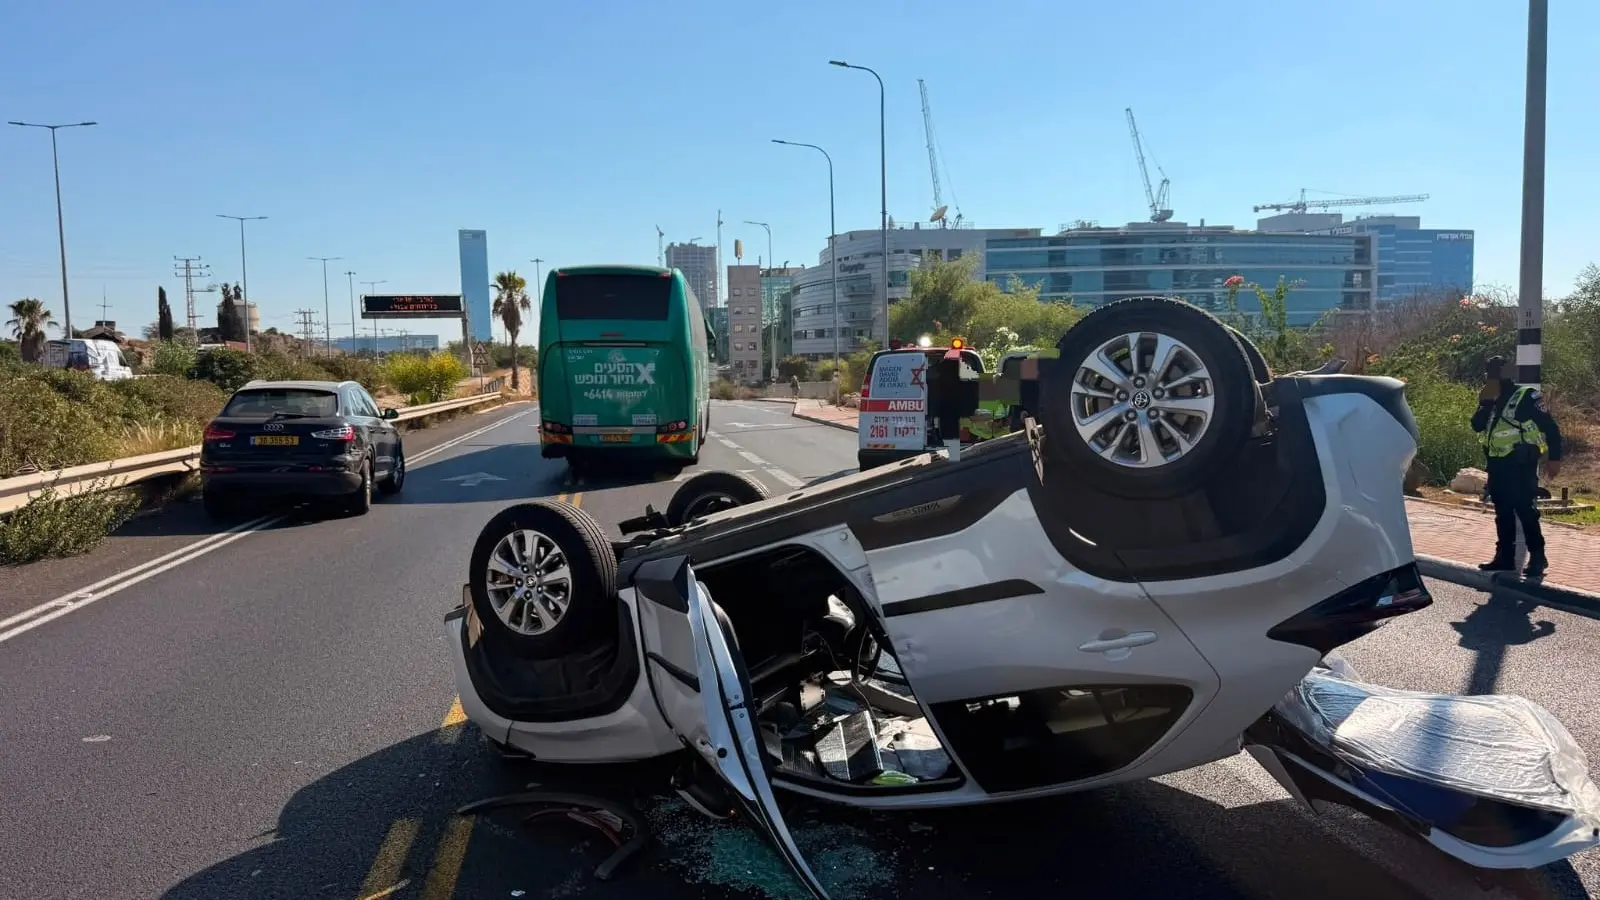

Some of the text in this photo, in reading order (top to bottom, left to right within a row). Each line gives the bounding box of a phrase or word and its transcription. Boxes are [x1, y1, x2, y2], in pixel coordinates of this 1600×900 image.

[594, 363, 634, 373] הסעים
[574, 374, 634, 385] תיור ונופש
[888, 400, 924, 411] AMBU
[870, 425, 920, 438] ירקון 2161
